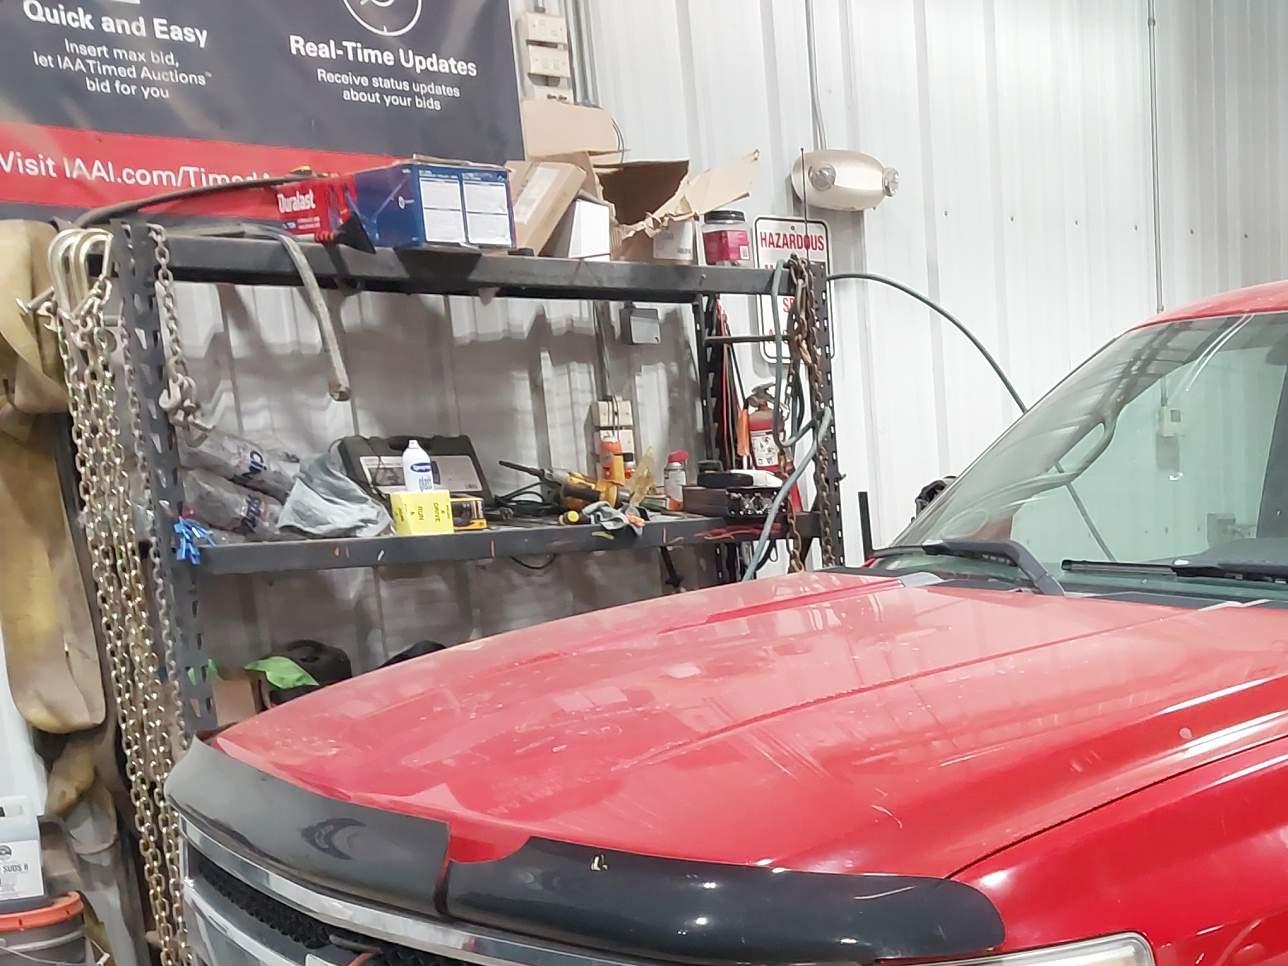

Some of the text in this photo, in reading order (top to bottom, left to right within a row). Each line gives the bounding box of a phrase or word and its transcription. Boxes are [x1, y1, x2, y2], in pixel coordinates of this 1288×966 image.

[23, 0, 208, 48] Quick and Easy
[33, 51, 54, 68] let
[64, 38, 179, 68] Insert max bid,
[289, 35, 477, 77] Real-Time Updates
[86, 77, 169, 99] bid for you
[317, 68, 460, 98] Receive status updates
[343, 89, 441, 111] about your bids
[0, 150, 56, 177] Visit
[277, 188, 316, 214] Duralast
[760, 232, 825, 251] HAZARDOUS
